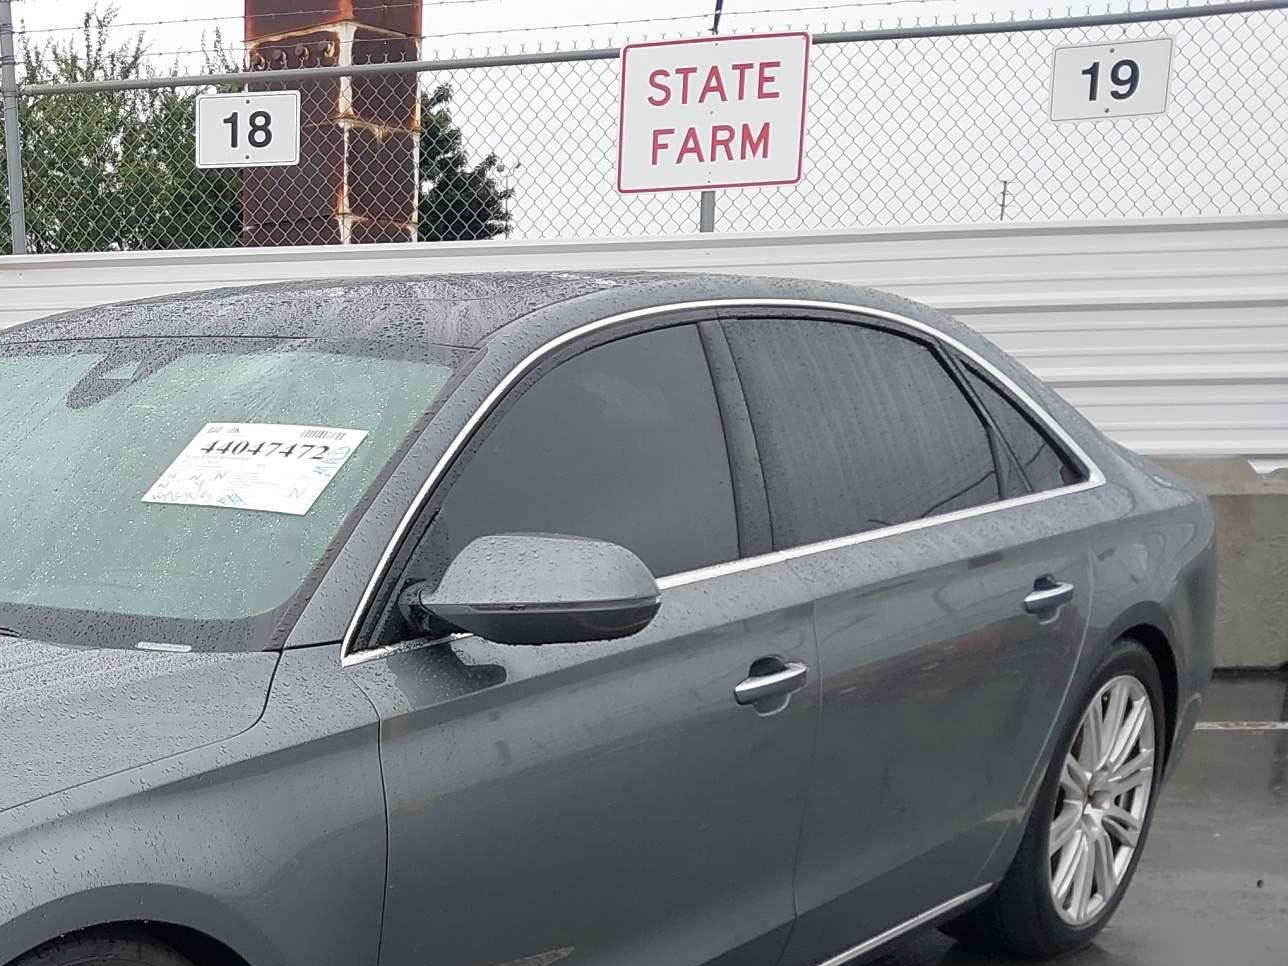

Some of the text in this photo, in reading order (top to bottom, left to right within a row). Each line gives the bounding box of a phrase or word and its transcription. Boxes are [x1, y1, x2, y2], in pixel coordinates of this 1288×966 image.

[648, 61, 779, 107] STATE
[1082, 59, 1140, 101] 19
[222, 110, 272, 148] 18
[651, 121, 772, 164] FARM
[200, 439, 330, 461] 44047472
